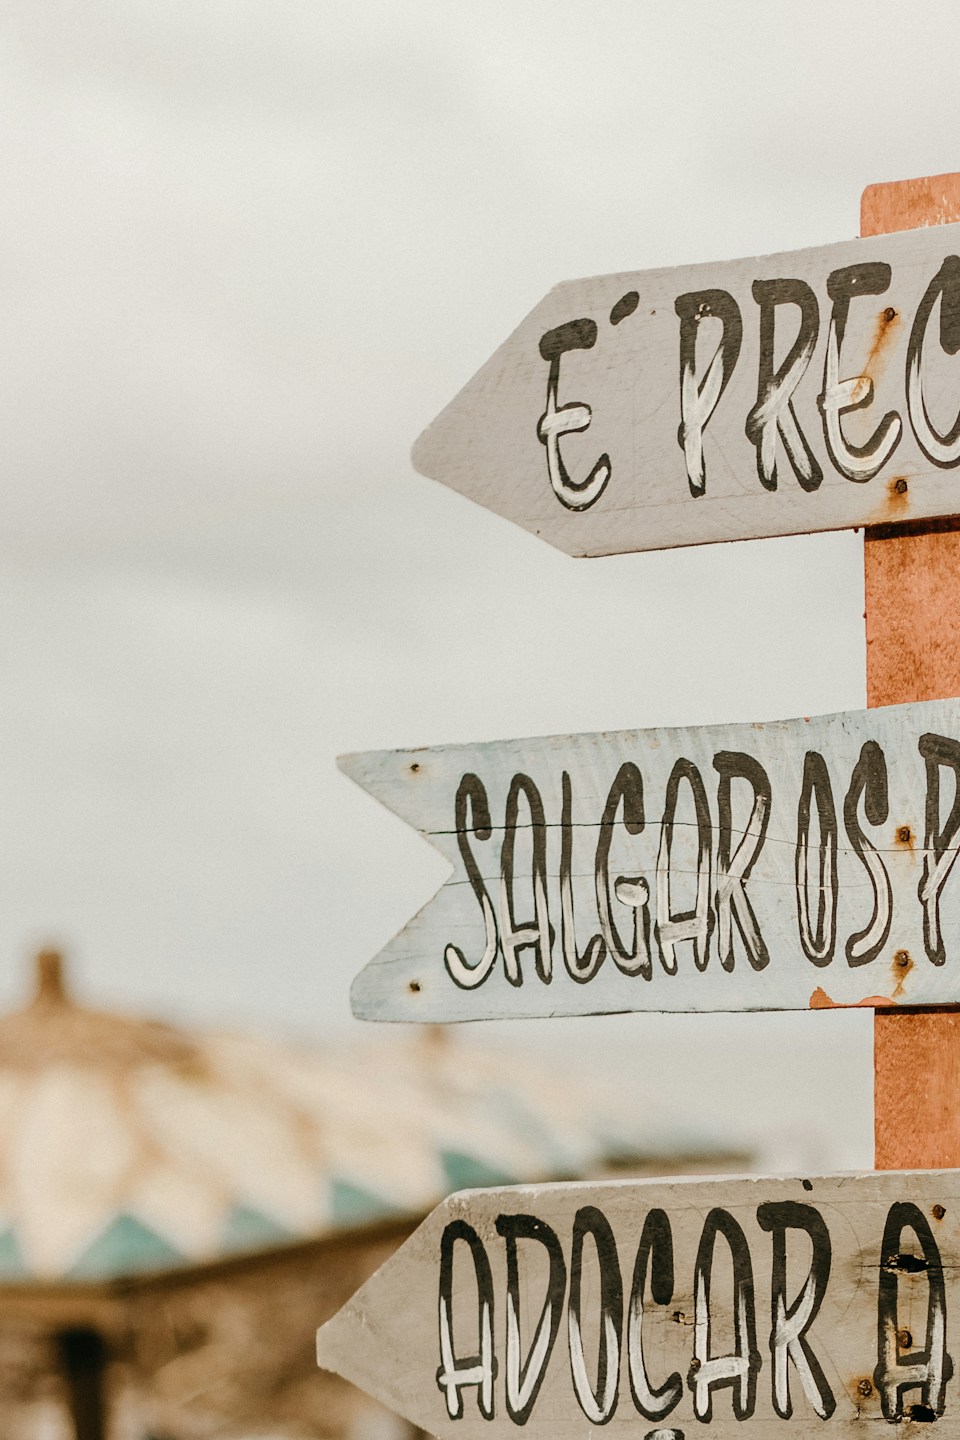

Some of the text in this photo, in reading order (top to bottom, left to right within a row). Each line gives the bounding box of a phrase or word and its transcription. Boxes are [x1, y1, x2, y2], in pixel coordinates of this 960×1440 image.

[444, 750, 770, 990] SALGAR
[799, 739, 892, 968] OS
[873, 1200, 952, 1422] A
